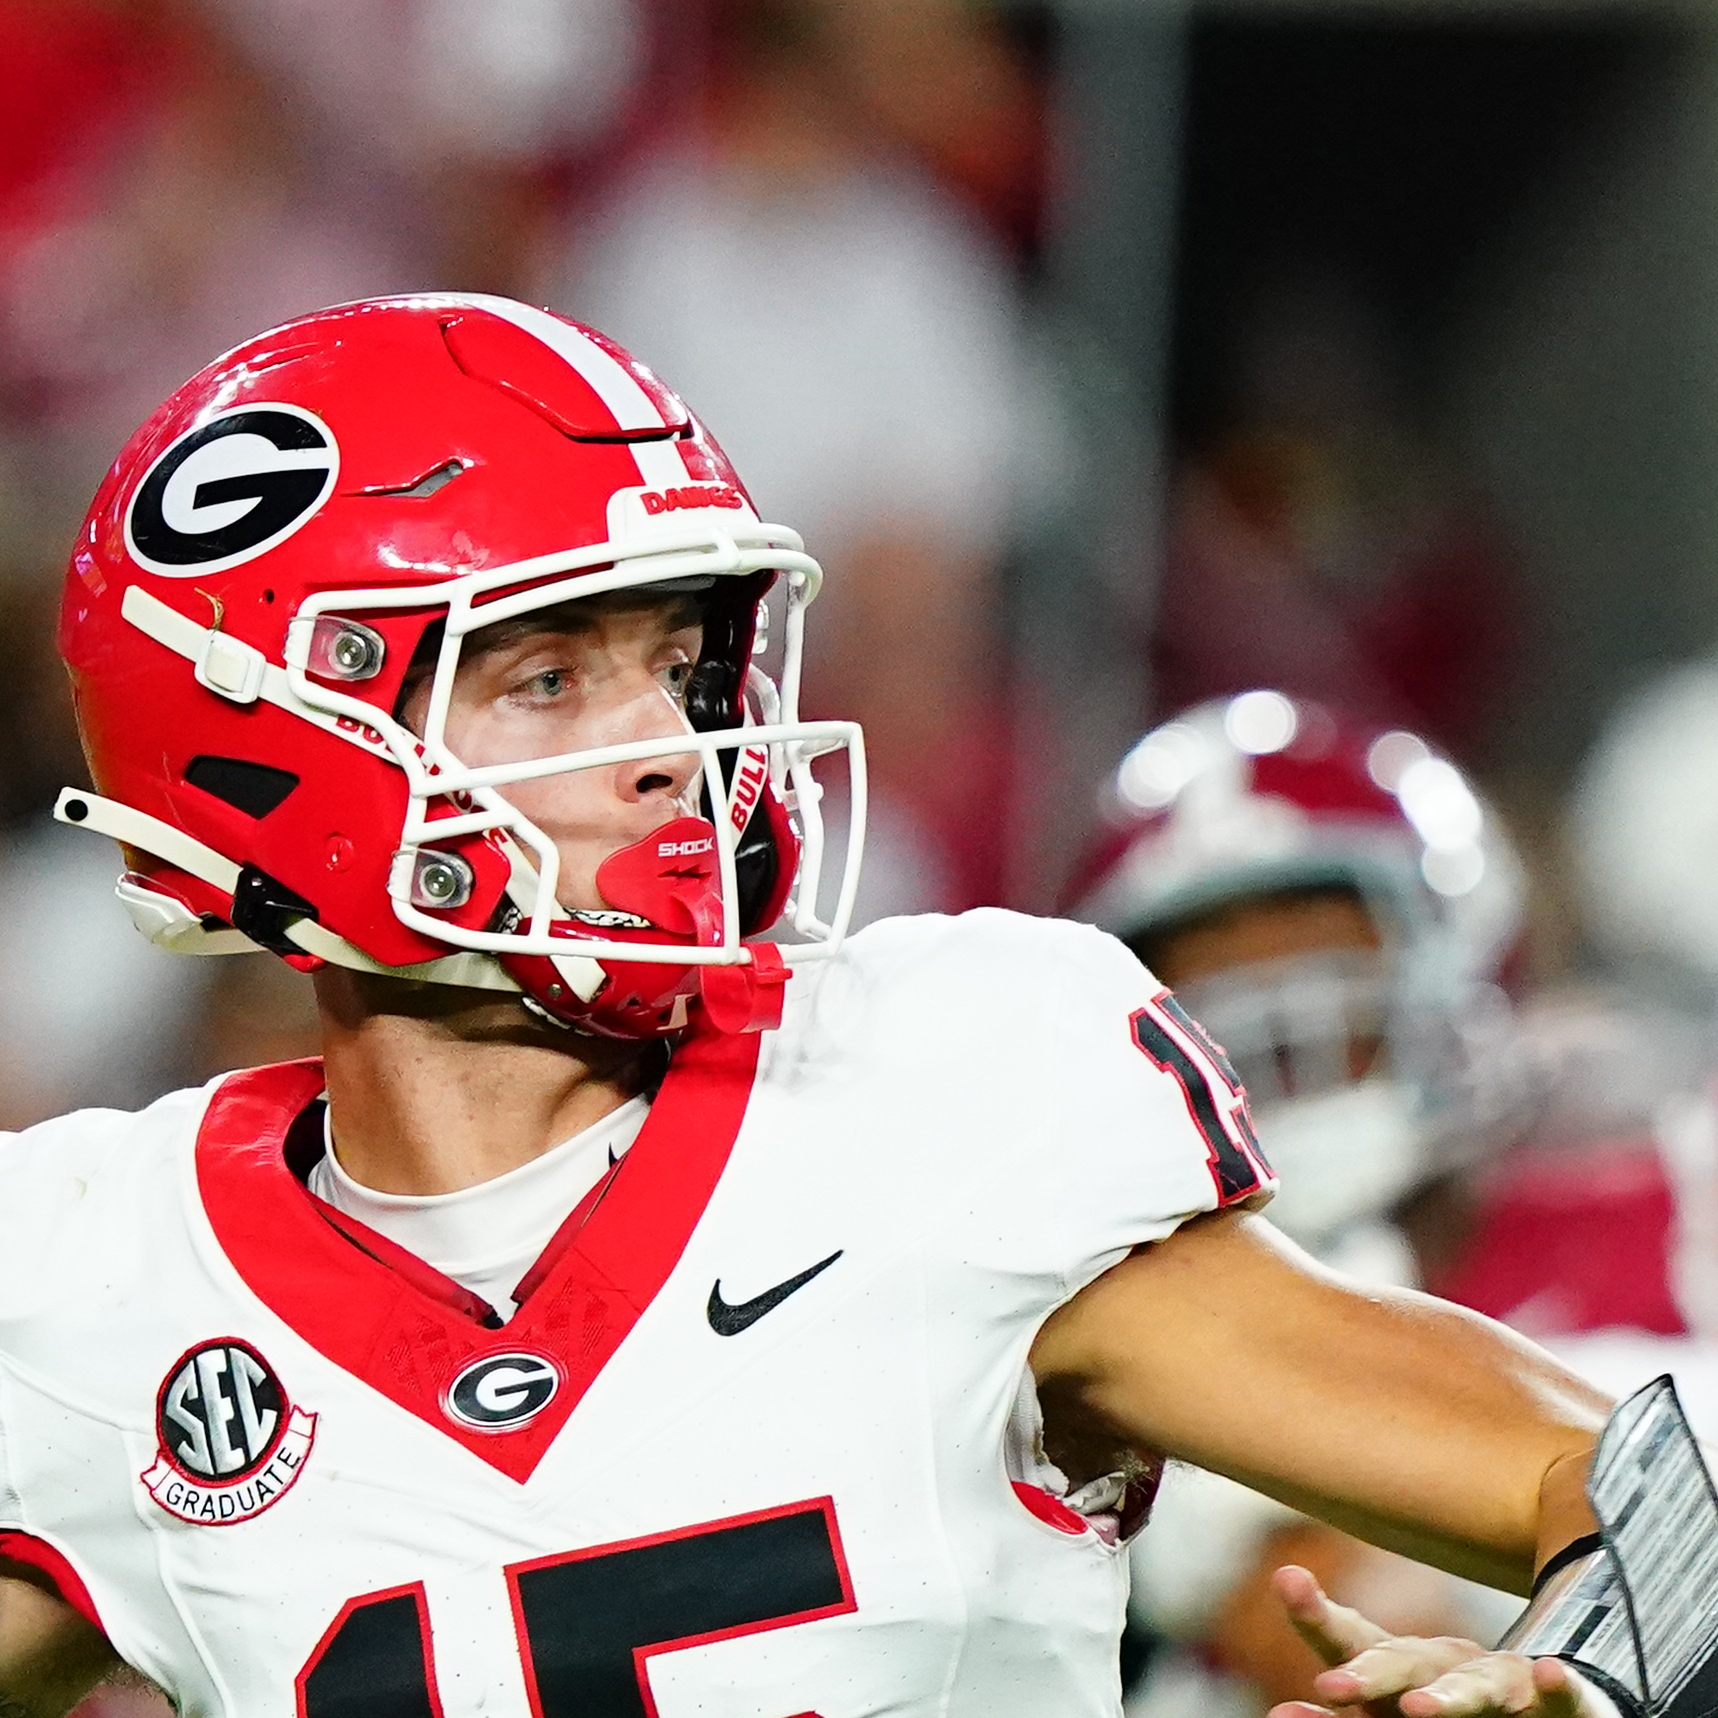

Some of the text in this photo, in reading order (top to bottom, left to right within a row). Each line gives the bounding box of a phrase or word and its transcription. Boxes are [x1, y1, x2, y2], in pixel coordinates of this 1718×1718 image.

[131, 410, 330, 566] G
[658, 837, 714, 857] SHOCK
[165, 1347, 278, 1476] SEC
[452, 1356, 555, 1424] G
[166, 1446, 302, 1520] GRADUATE
